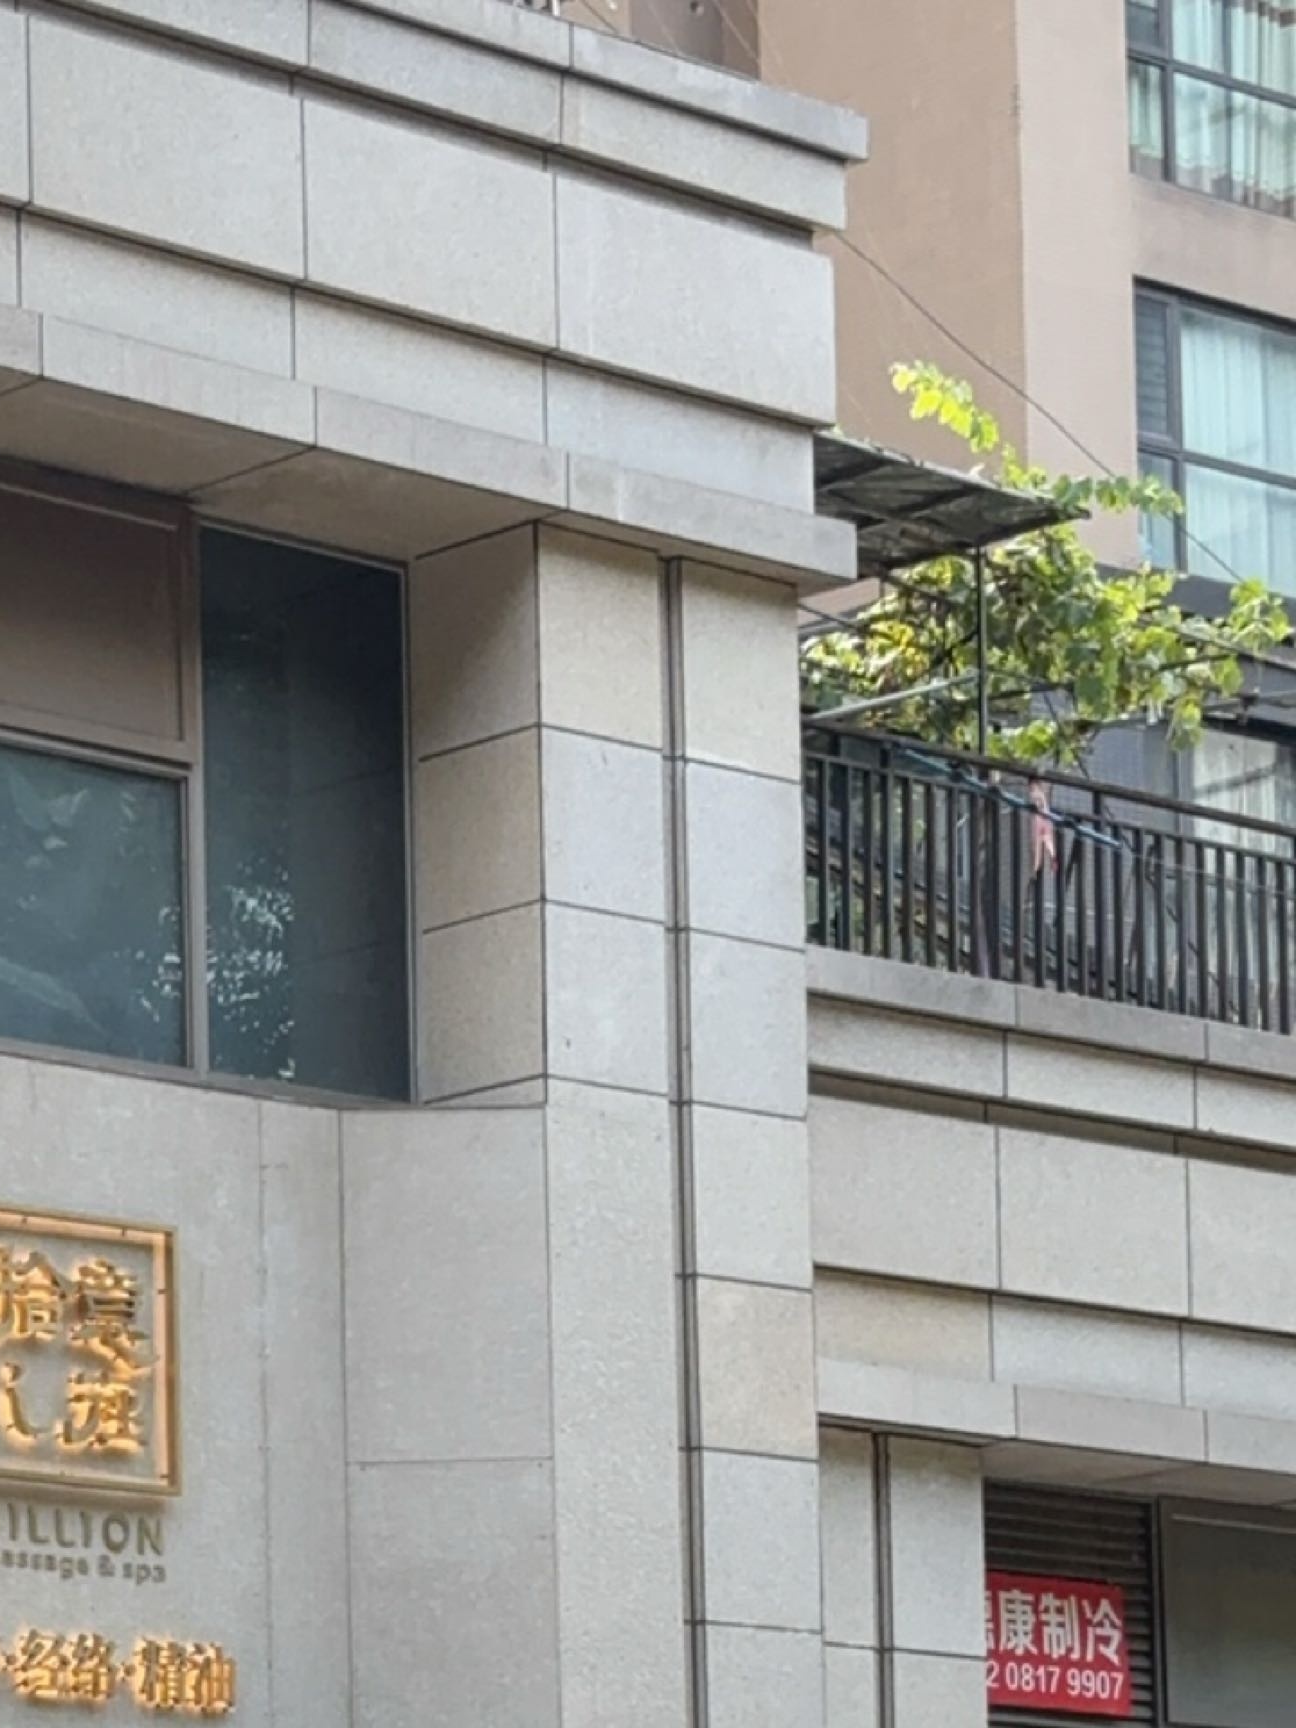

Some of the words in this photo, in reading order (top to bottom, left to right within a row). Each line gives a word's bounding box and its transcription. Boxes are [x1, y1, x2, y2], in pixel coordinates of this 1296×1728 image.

[123, 1562, 167, 1586] spa
[1005, 1663, 1059, 1692] 0817
[1066, 1671, 1124, 1700] 9907
